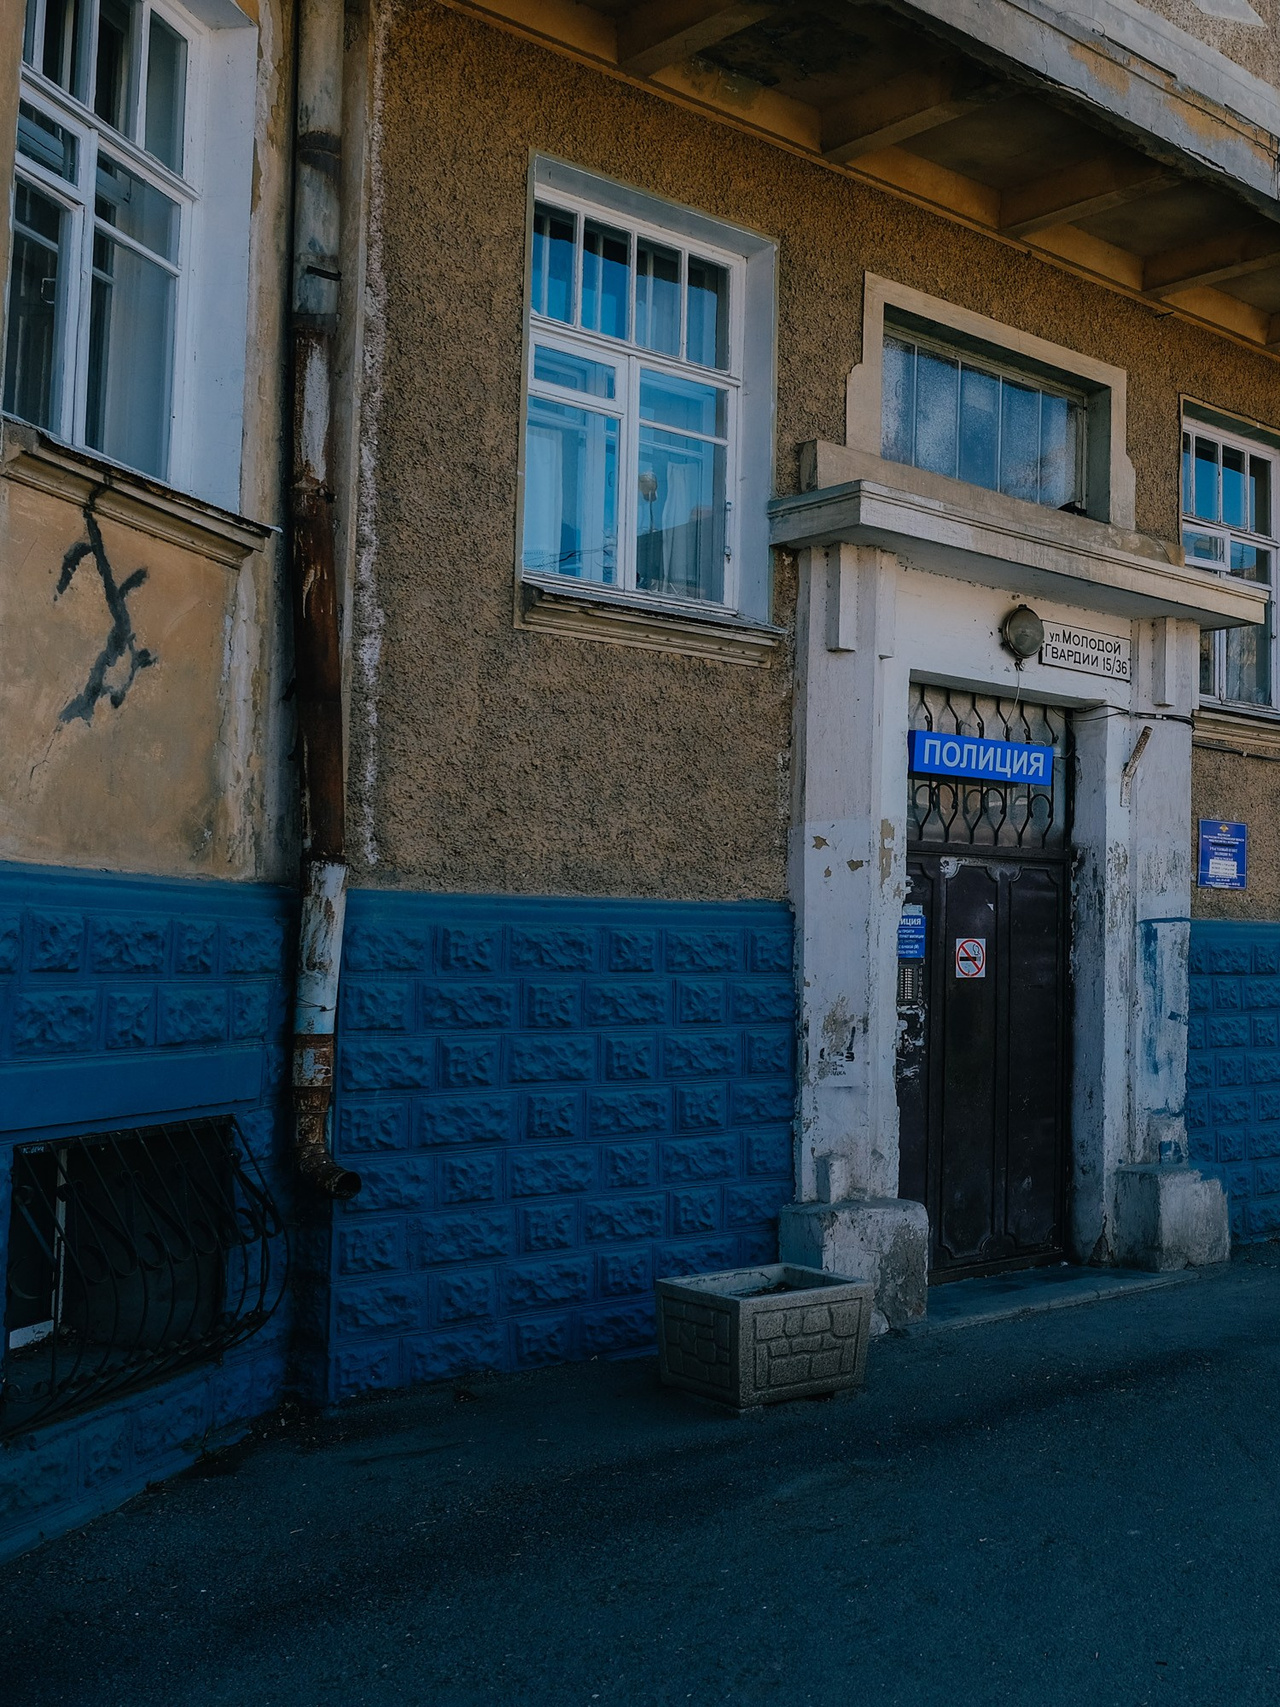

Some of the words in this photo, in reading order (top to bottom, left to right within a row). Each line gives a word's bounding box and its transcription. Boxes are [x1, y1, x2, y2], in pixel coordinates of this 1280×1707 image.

[1045, 643, 1099, 667] ГВАРДИИ
[1102, 656, 1128, 675] 15/36
[923, 738, 1045, 779] ПОЛИЦИЯ
[900, 918, 921, 926] ИЦИЯ
